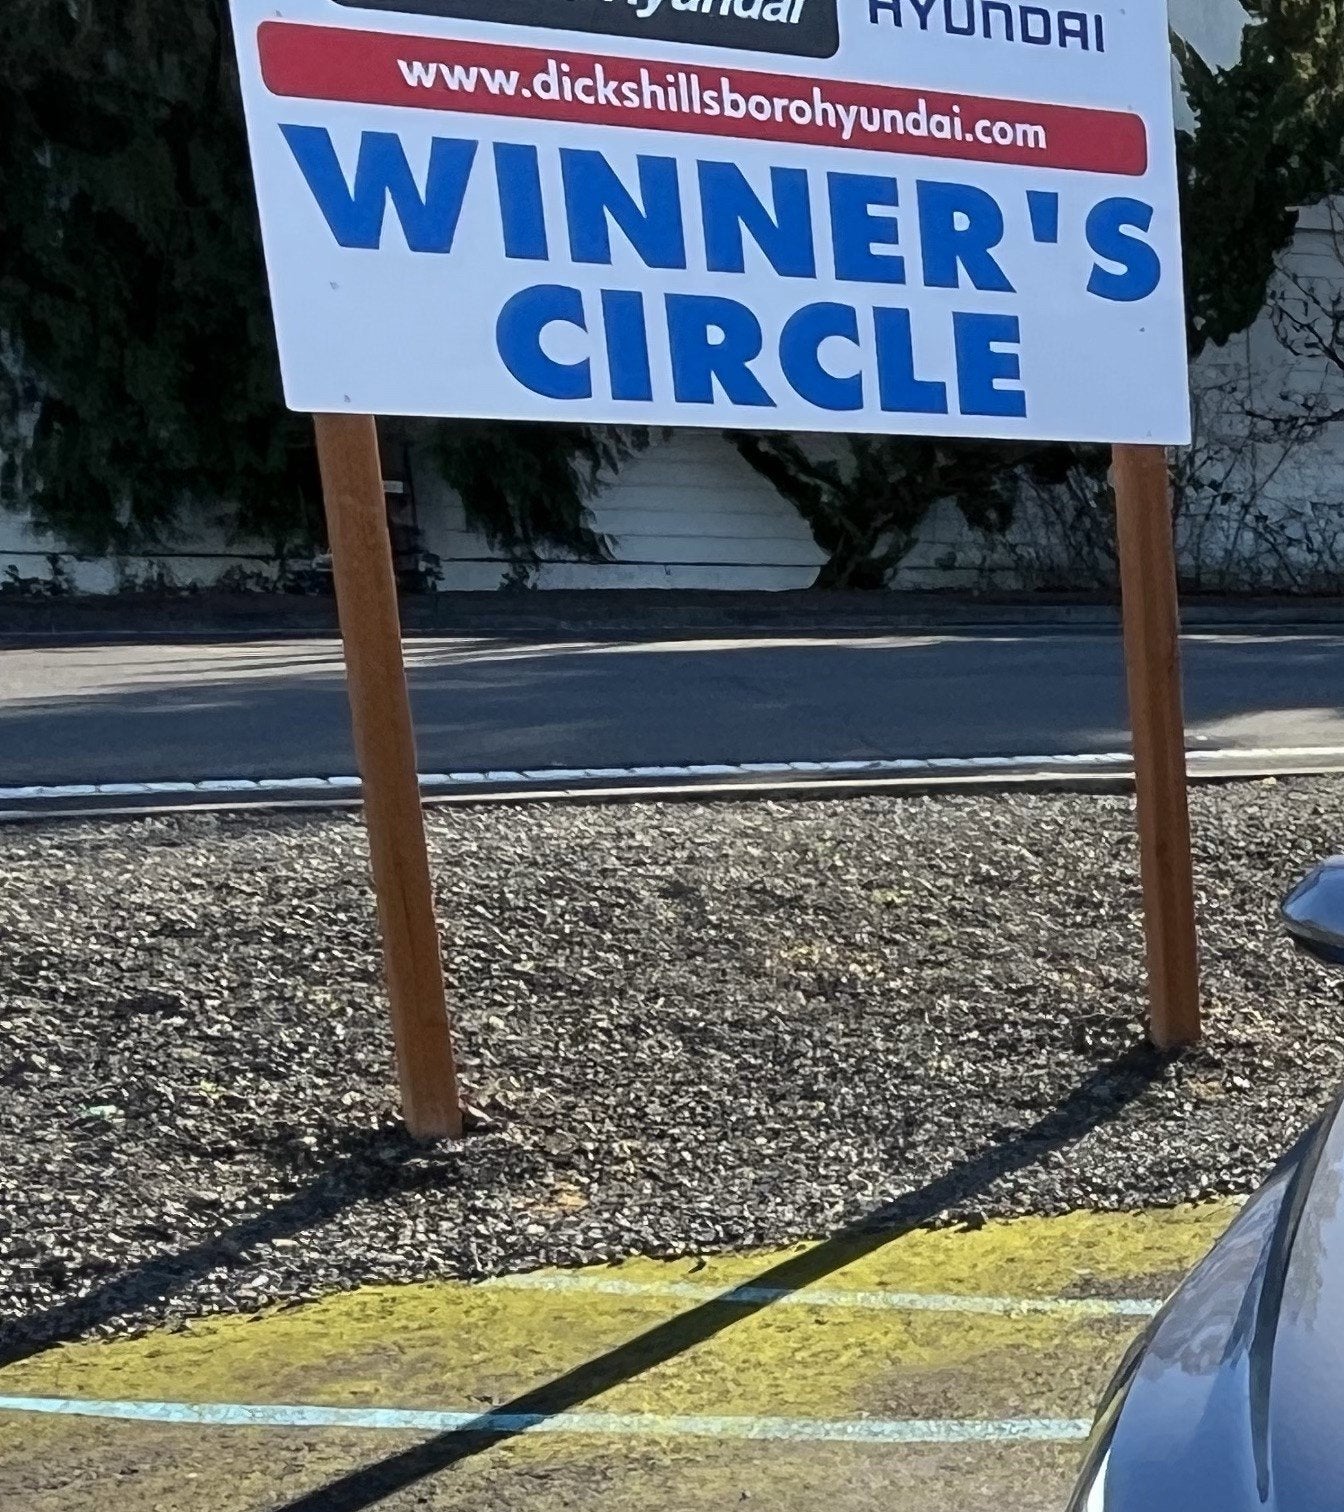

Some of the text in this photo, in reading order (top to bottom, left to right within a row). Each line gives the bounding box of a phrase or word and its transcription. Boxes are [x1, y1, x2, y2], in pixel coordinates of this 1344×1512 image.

[869, 0, 1105, 52] HYUNDAI
[397, 57, 1047, 149] www.dickshillsborohyundai.com
[277, 123, 1161, 302] WINNER'S
[496, 284, 1027, 419] CIRCLE
